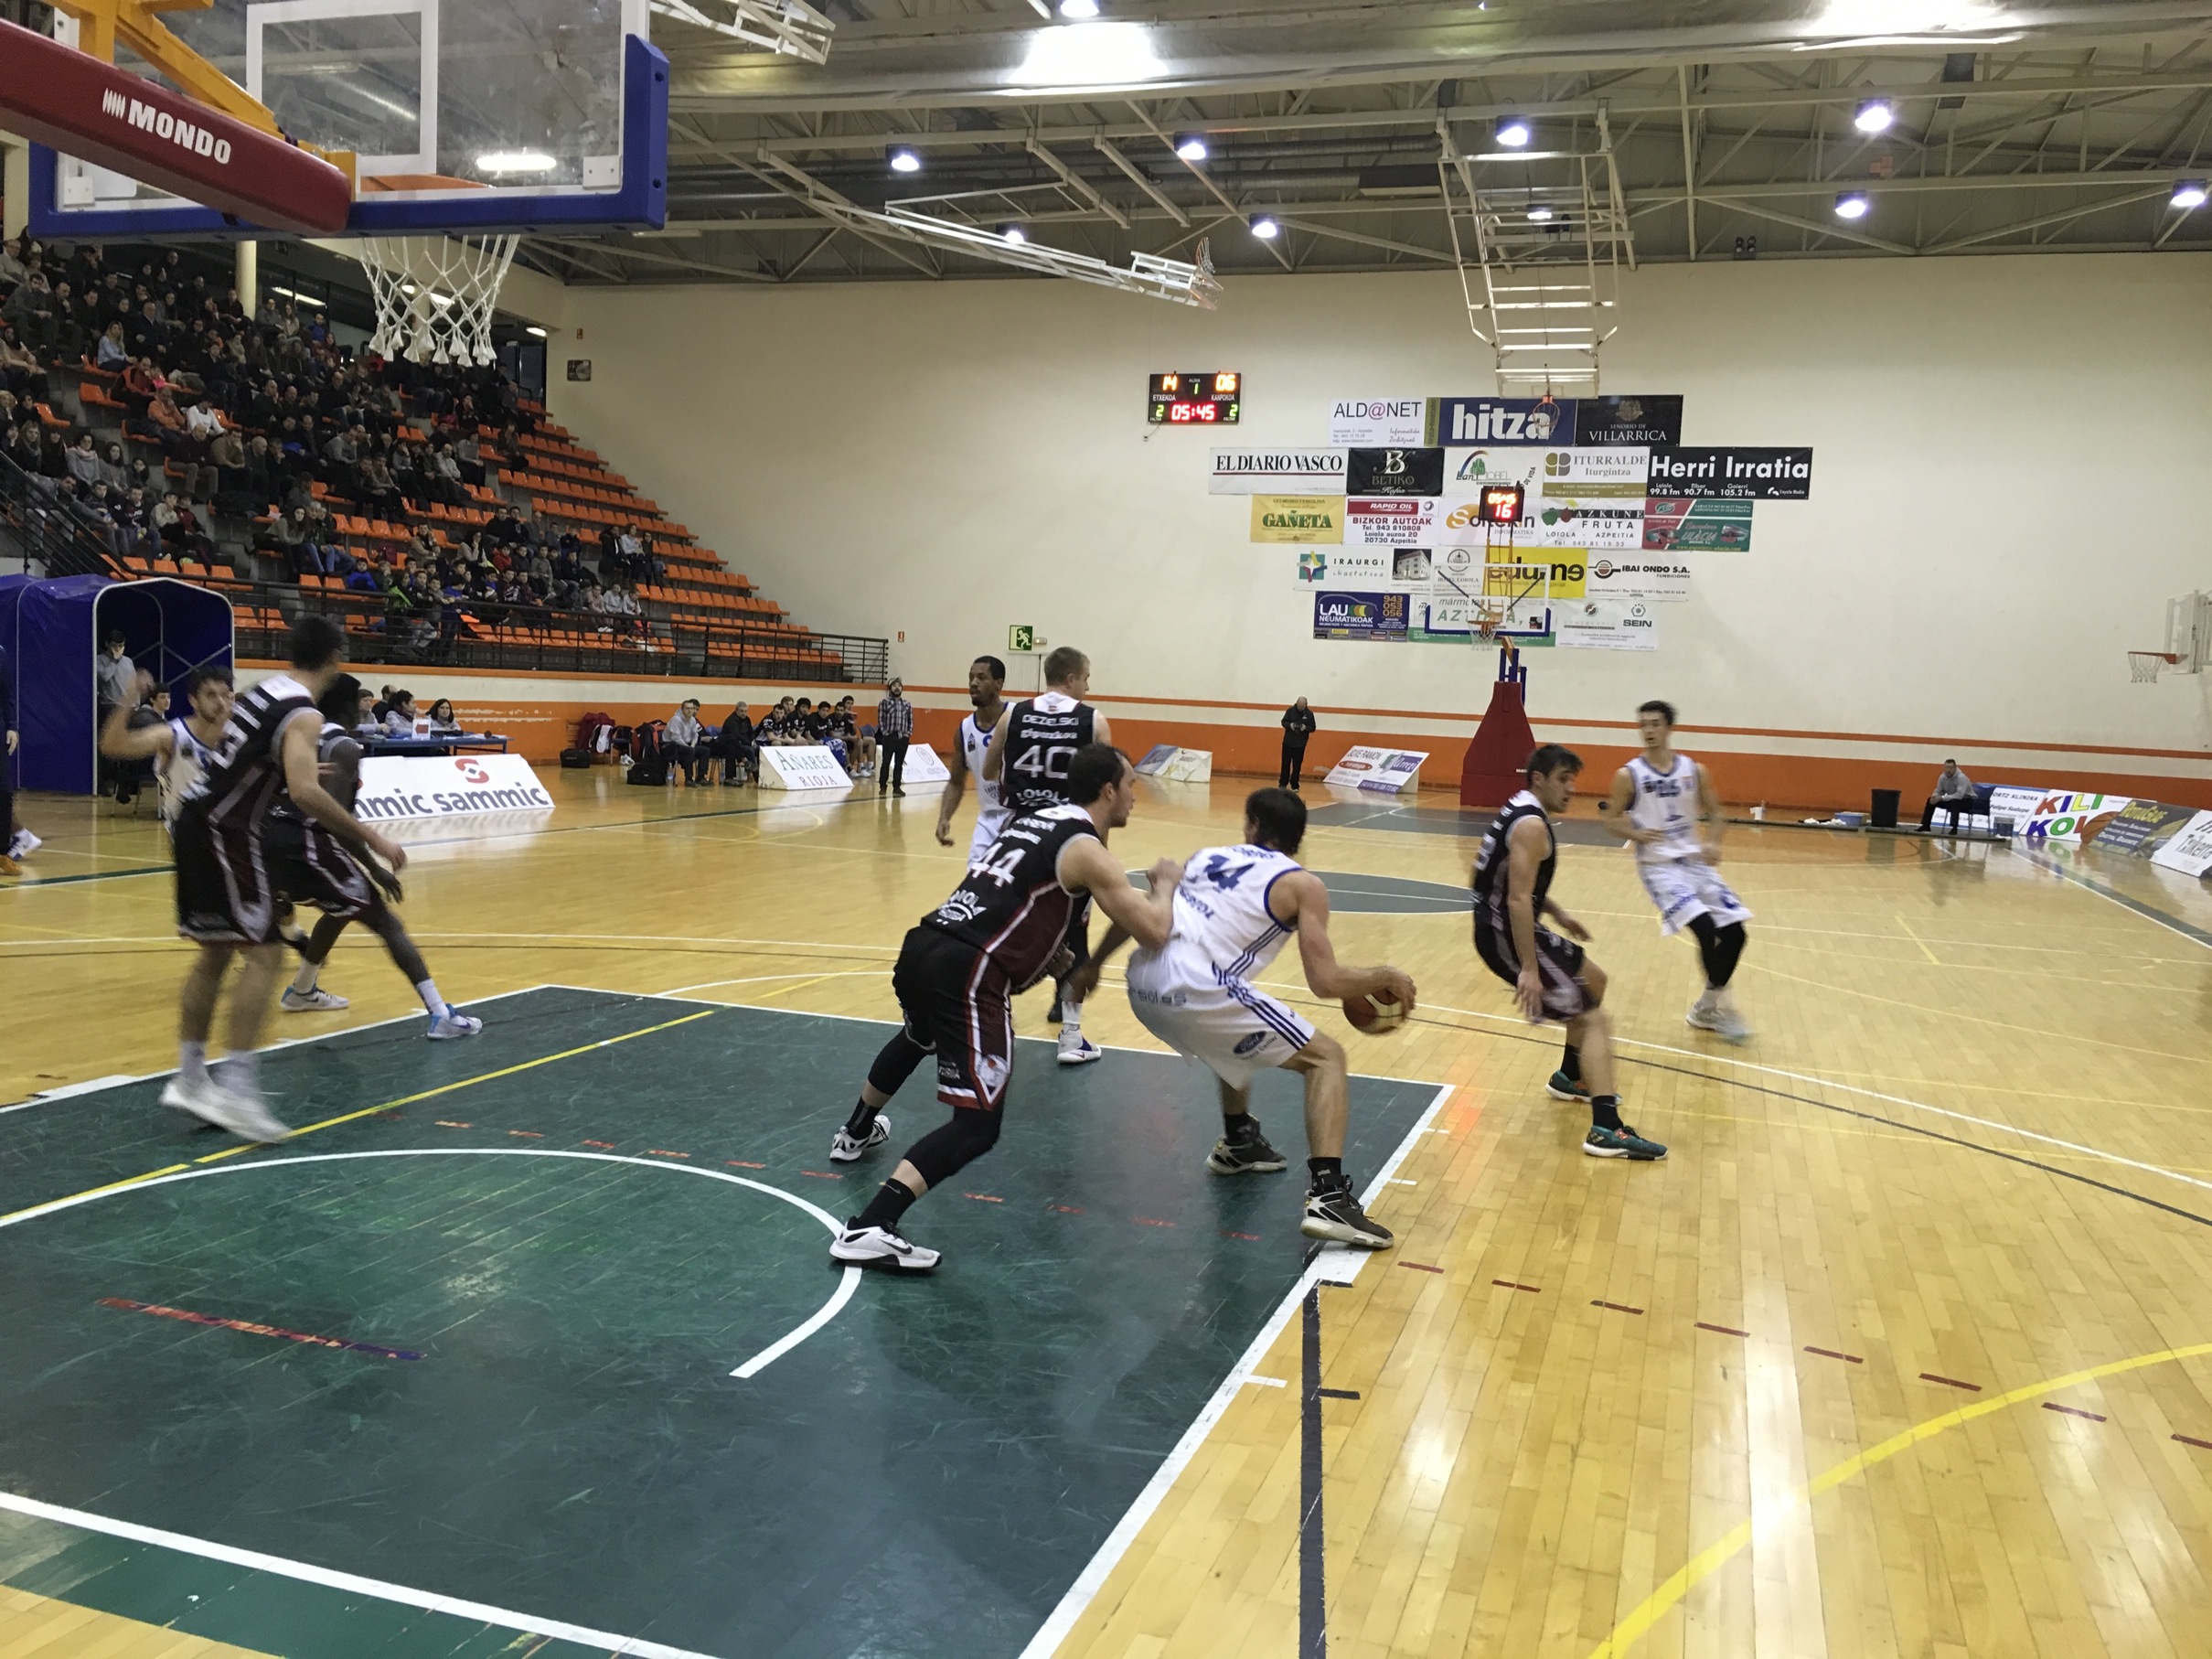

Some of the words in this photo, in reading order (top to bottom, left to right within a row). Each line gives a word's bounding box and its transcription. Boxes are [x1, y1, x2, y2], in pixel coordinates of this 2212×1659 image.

[128, 98, 231, 165] MONDO
[1162, 375, 1178, 391] 14
[1215, 374, 1235, 391] 06
[1193, 383, 1199, 394] 1
[1156, 404, 1165, 417] 2
[1171, 404, 1214, 420] 05:45
[1229, 404, 1238, 417] 2
[1334, 401, 1422, 420] ALD@NET
[1452, 403, 1551, 440] hitza
[1589, 430, 1667, 441] VILLARRICA
[1216, 455, 1235, 471] EL
[1238, 455, 1291, 471] DIARIO
[1294, 455, 1342, 471] VASCO
[1574, 455, 1647, 466] ITURRALDE
[1651, 455, 1716, 478] Herri
[1726, 456, 1809, 478] Irratia
[1456, 470, 1474, 480] Lan
[1528, 466, 1536, 479] VIDA
[1585, 468, 1631, 477] Iturgintza
[1372, 476, 1415, 486] BETIKO
[1495, 504, 1512, 519] 16
[1576, 509, 1643, 518] AZKUNE
[1262, 509, 1333, 529] GAÑETA
[1582, 520, 1633, 529] FRUTA
[1333, 558, 1384, 566] IRAURGI
[1384, 594, 1403, 603] 943
[1320, 604, 1349, 616] LAU
[1319, 615, 1373, 624] NEUMATIKOAK
[1623, 619, 1652, 627] SEIN
[1021, 714, 1079, 726] DEZELSKI
[775, 748, 834, 771] AÑARES
[800, 776, 838, 787] RIOJA
[355, 787, 433, 819] mmic
[433, 781, 550, 812] sammic
[2035, 794, 2103, 816] KILI
[971, 842, 1027, 888] 44
